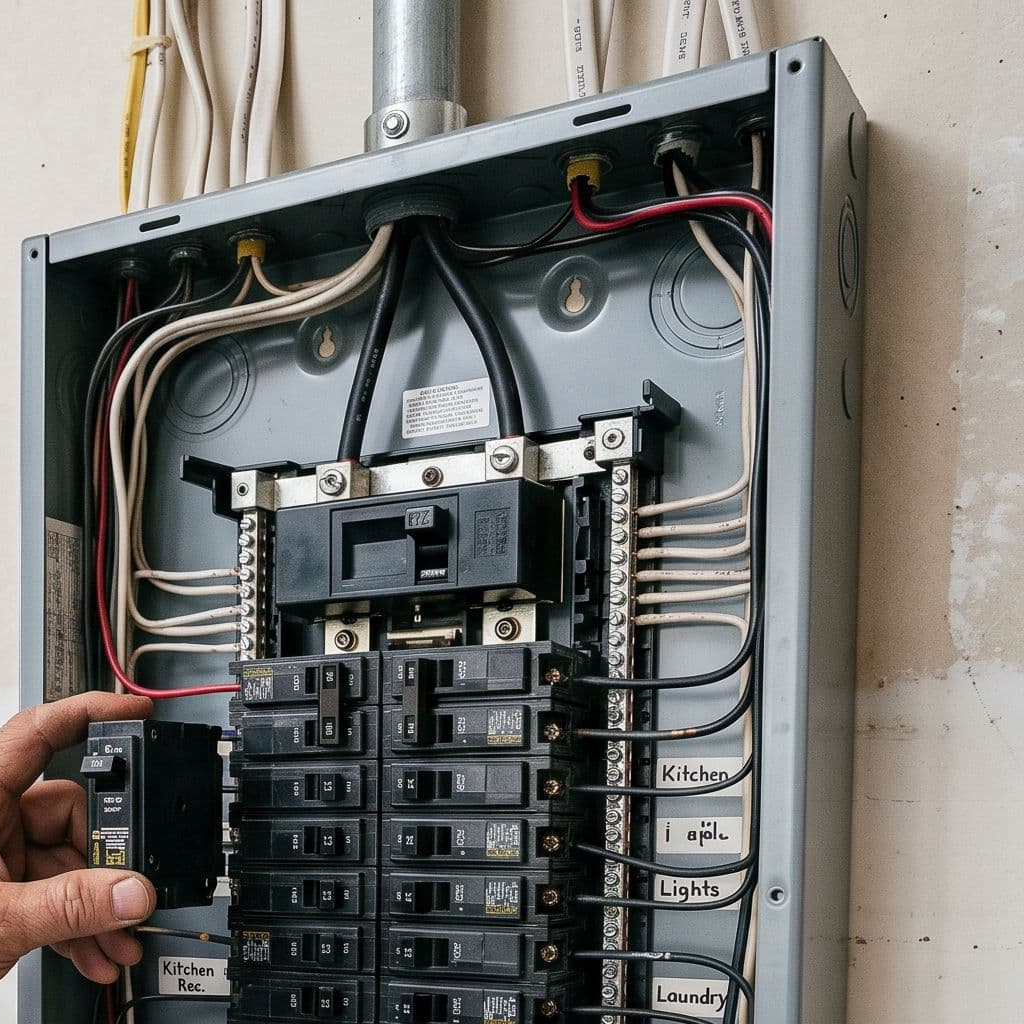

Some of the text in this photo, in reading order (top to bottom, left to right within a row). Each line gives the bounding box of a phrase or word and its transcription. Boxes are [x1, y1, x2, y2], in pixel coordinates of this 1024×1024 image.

[662, 764, 729, 782] Kitchen
[660, 879, 720, 903] Lights
[163, 960, 215, 977] Kitchen
[178, 978, 205, 993] Rec.
[657, 985, 728, 1012] Laundry
